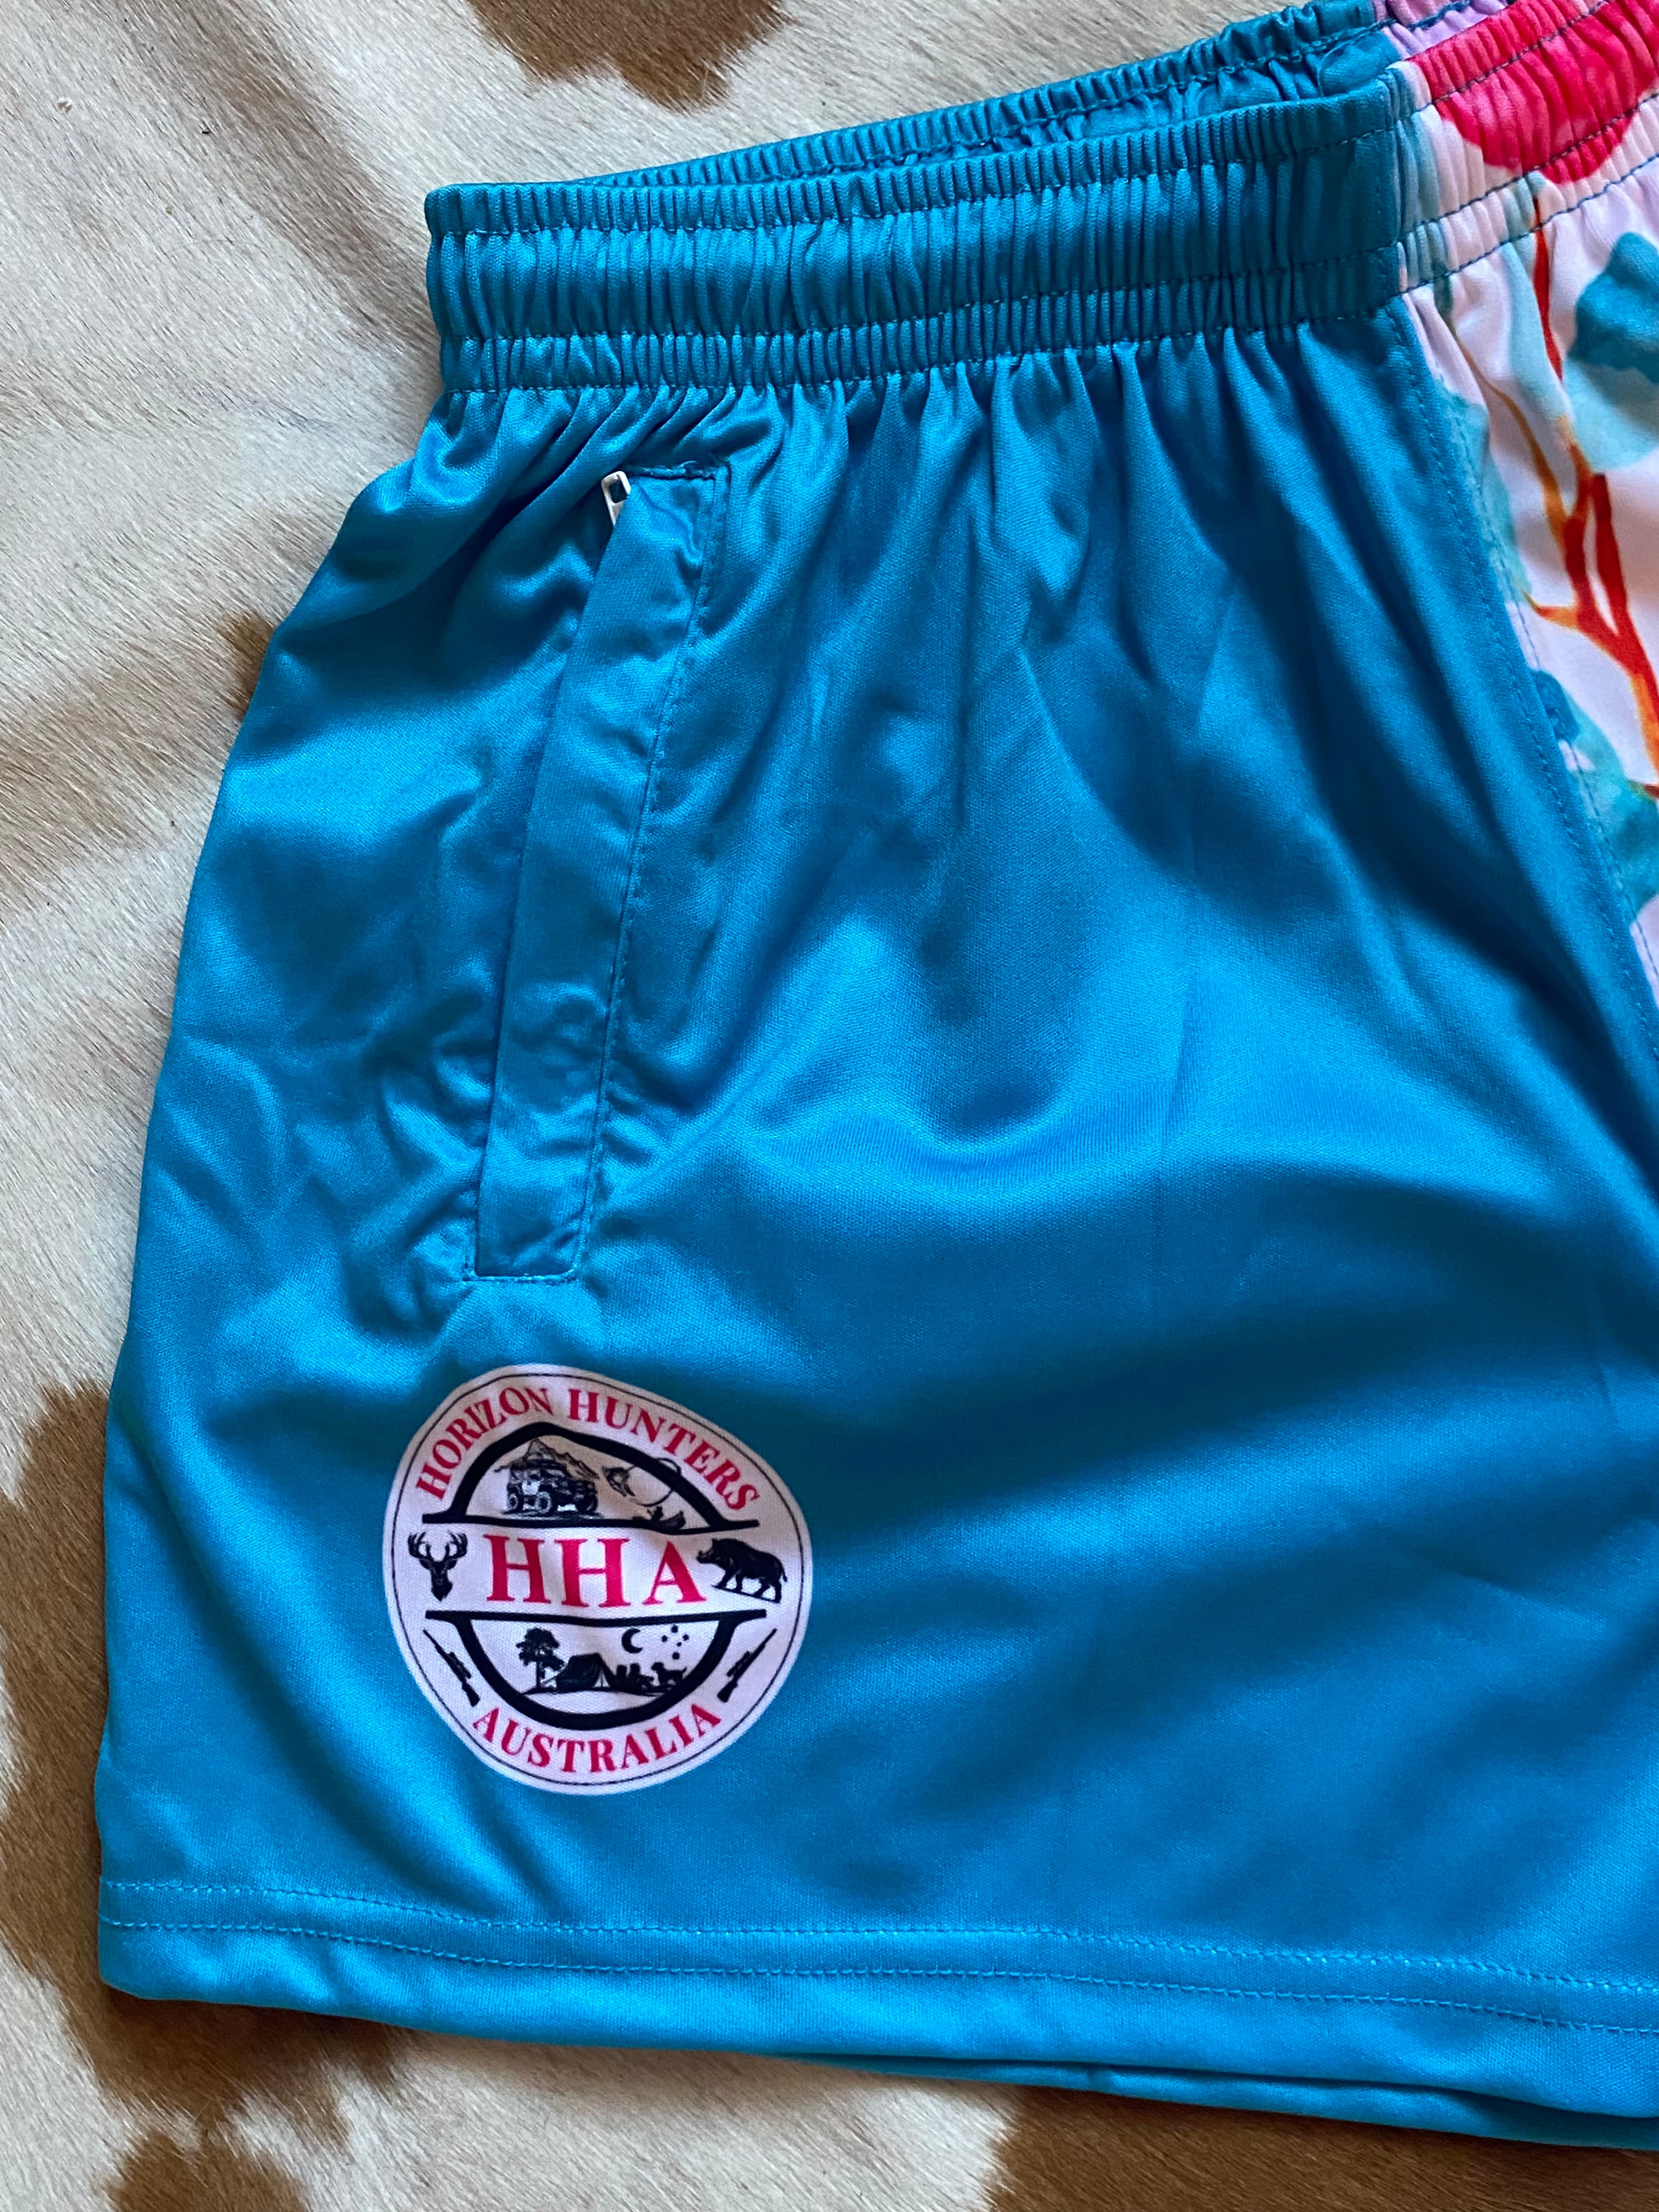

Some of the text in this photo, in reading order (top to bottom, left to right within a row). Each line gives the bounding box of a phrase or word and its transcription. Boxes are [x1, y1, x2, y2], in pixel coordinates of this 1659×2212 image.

[415, 1386, 760, 1511] HORIZON HUNTERS
[483, 1533, 707, 1609] HHA
[472, 1702, 723, 1774] AUSTRALIA
